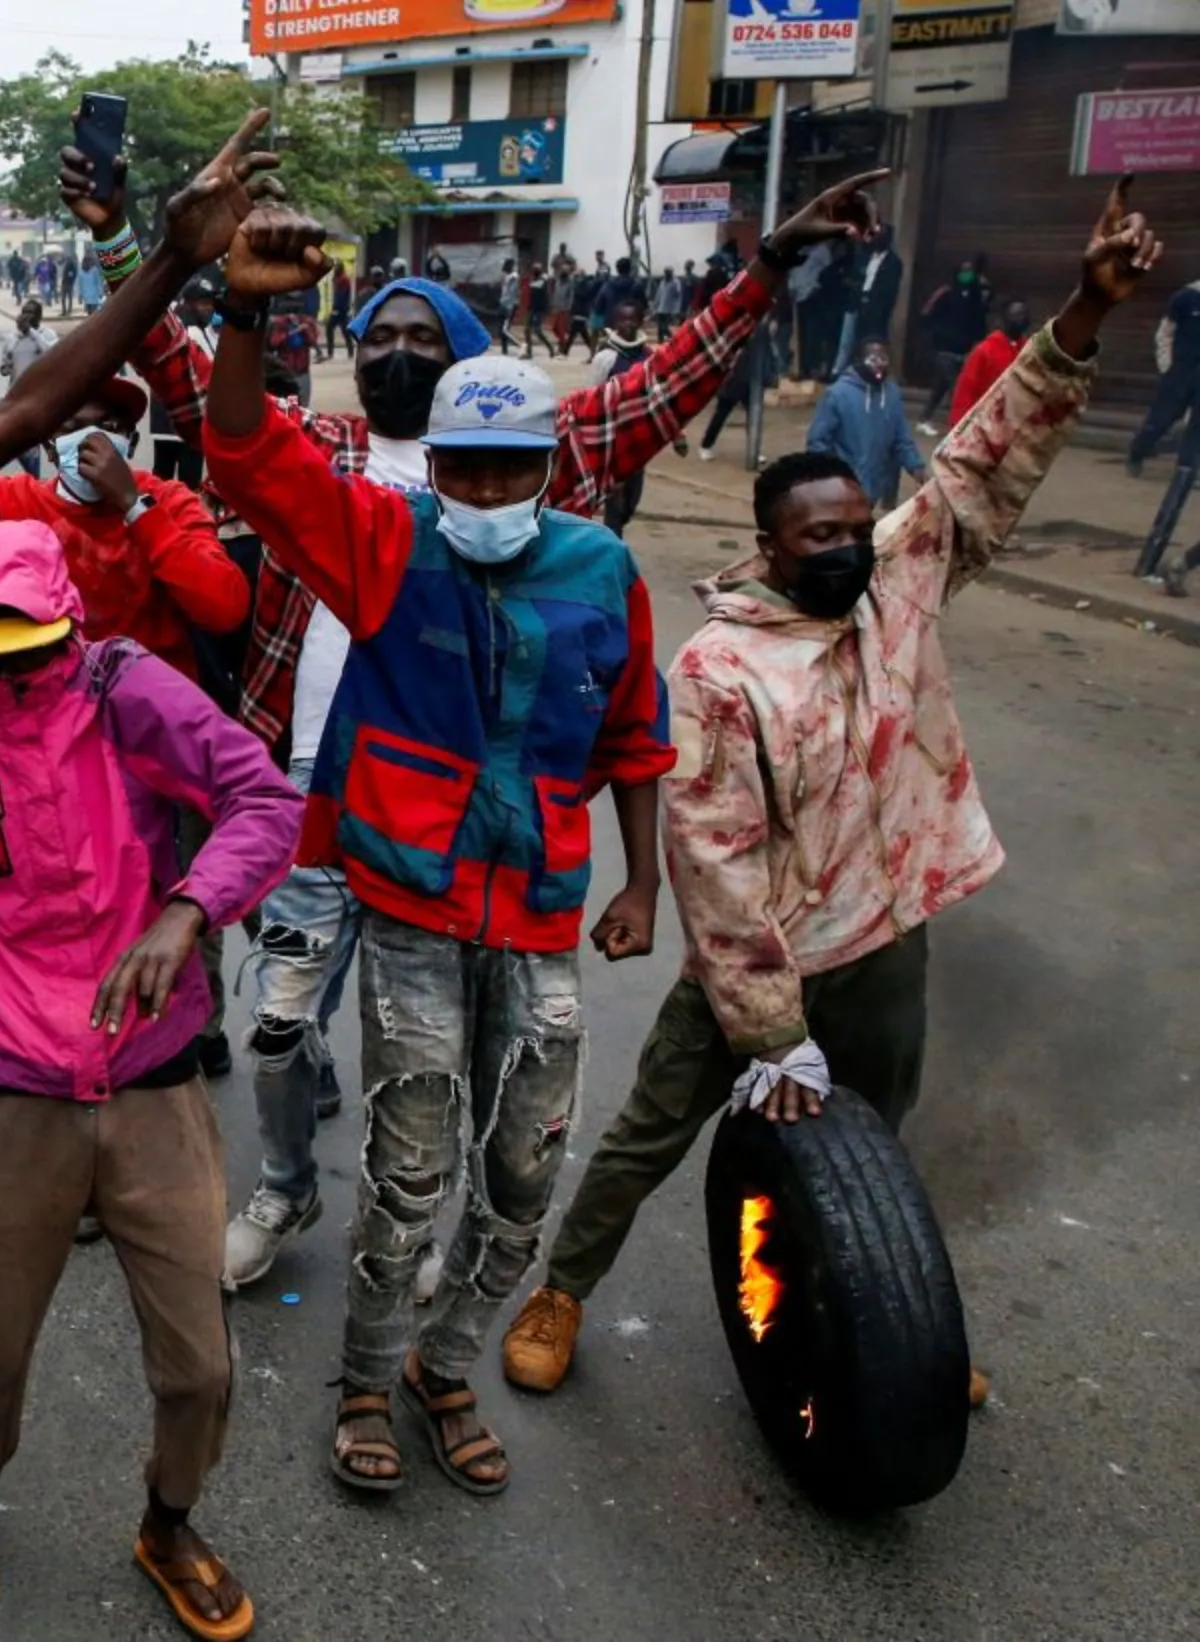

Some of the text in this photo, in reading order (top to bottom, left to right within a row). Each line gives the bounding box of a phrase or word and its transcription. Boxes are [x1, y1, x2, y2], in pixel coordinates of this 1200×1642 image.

[264, 8, 400, 39] STRENGTHENER
[733, 22, 853, 41] 0724 536 048
[892, 13, 1012, 41] EASTMATT
[454, 381, 526, 407] Bulls
